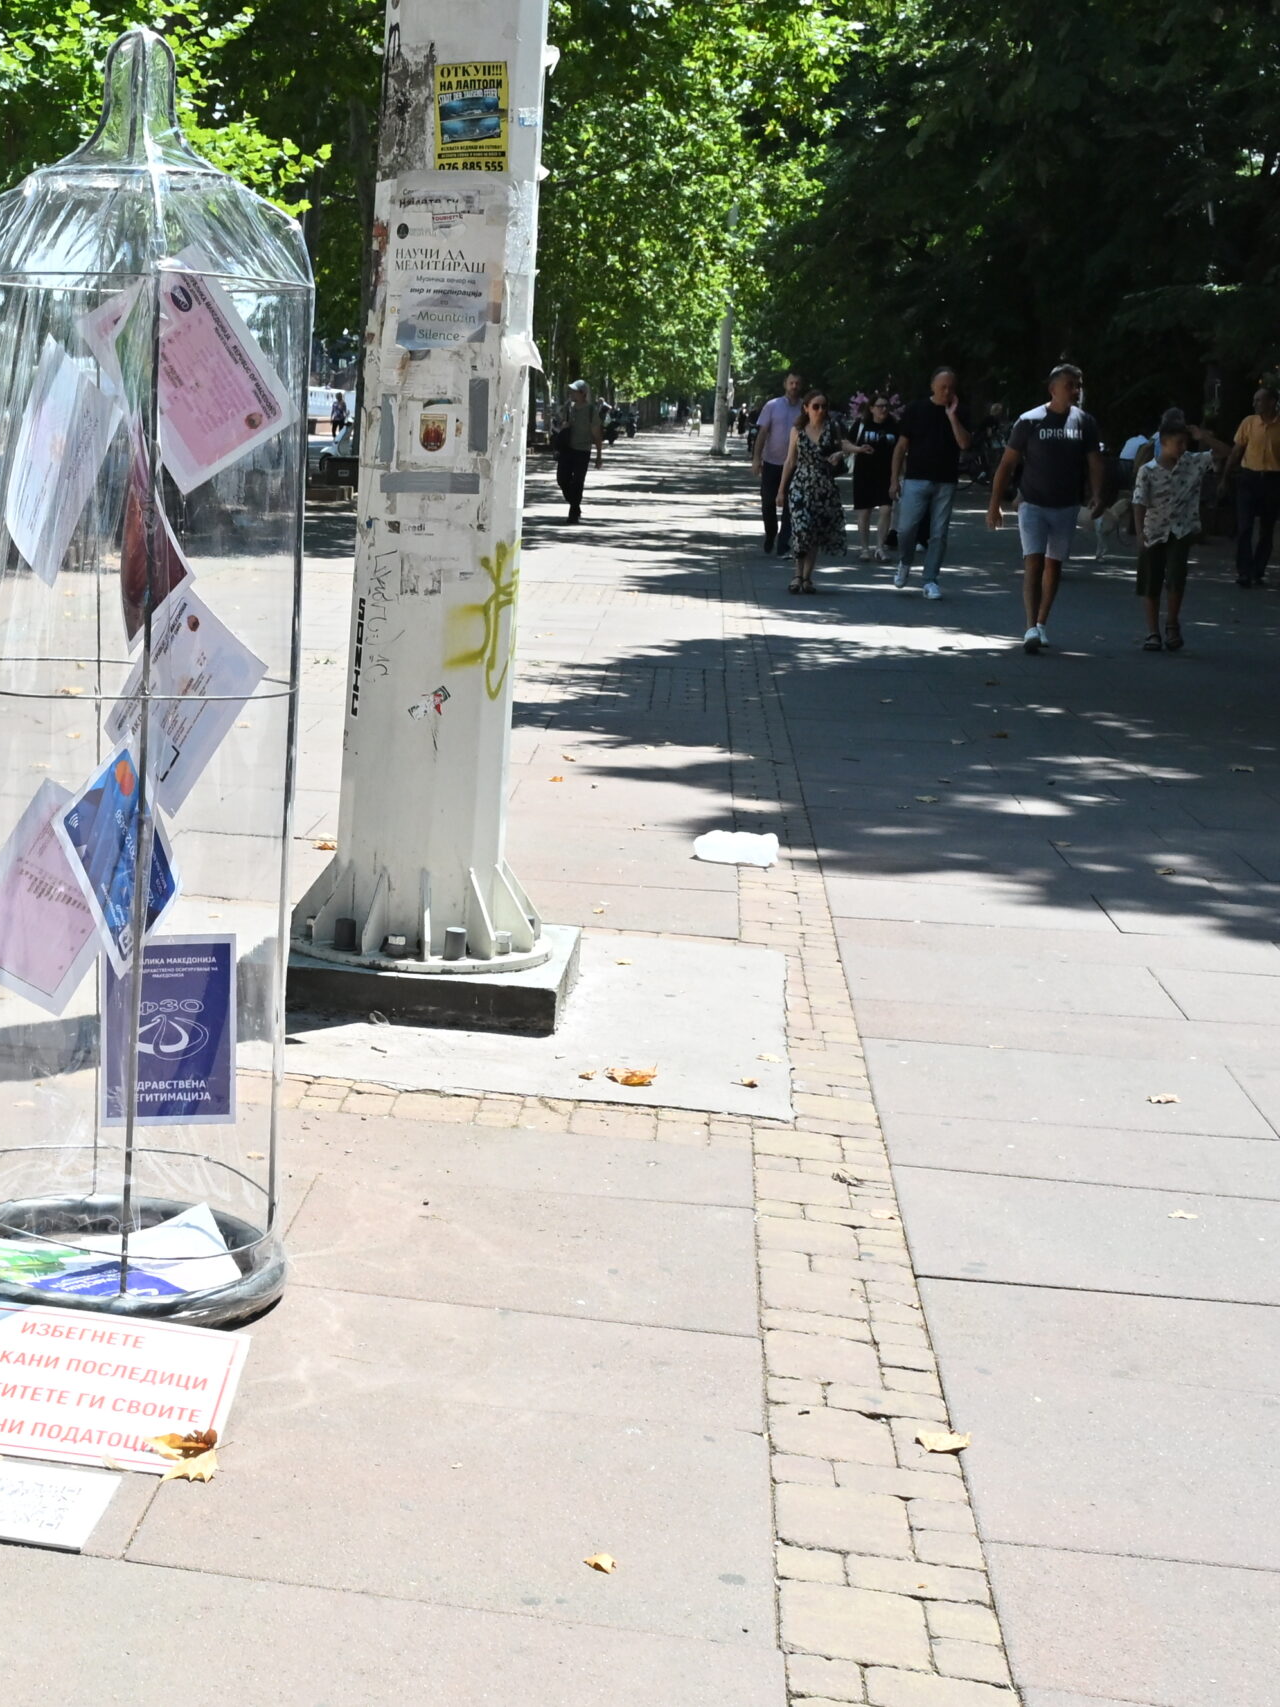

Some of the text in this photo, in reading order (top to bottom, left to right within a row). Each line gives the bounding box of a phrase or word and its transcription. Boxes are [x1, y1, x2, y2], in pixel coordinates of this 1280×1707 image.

[440, 64, 502, 78] ОТКУП!!!
[440, 79, 502, 91] НА ЛАПТОПИ
[485, 161, 503, 171] 555
[395, 248, 465, 261] НАУЧИ ДА
[166, 956, 217, 965] МАКЕДОНИЈА
[136, 1080, 206, 1091] ДРАВСТВЕНА
[20, 1321, 145, 1349] ИЗБЕГНЕТЕ
[66, 1358, 208, 1391] ПОСЛЕДИЦИ
[76, 1393, 105, 1409] ГИ
[111, 1397, 202, 1424] СВОИТЕ
